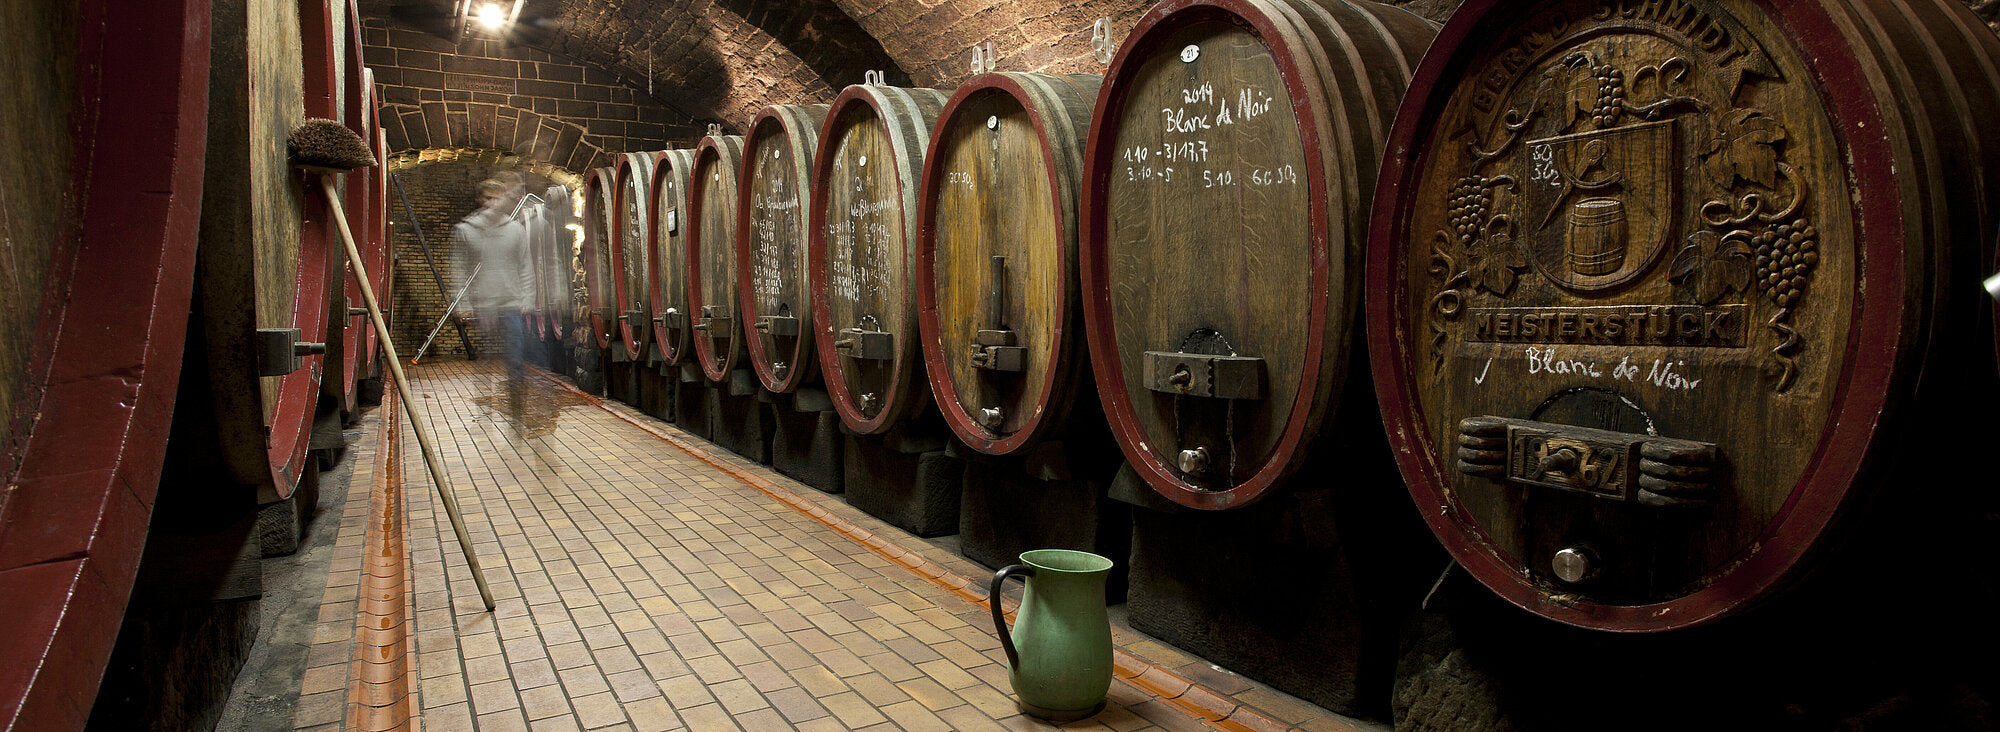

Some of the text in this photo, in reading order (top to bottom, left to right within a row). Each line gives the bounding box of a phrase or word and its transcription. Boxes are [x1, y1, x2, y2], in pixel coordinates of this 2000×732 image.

[1592, 0, 1753, 66] SCHMIDT
[1162, 87, 1272, 132] Blanc de Noir
[1474, 304, 1732, 342] MEISTERSTÜCK
[1526, 346, 1702, 390] Blanc de Noir
